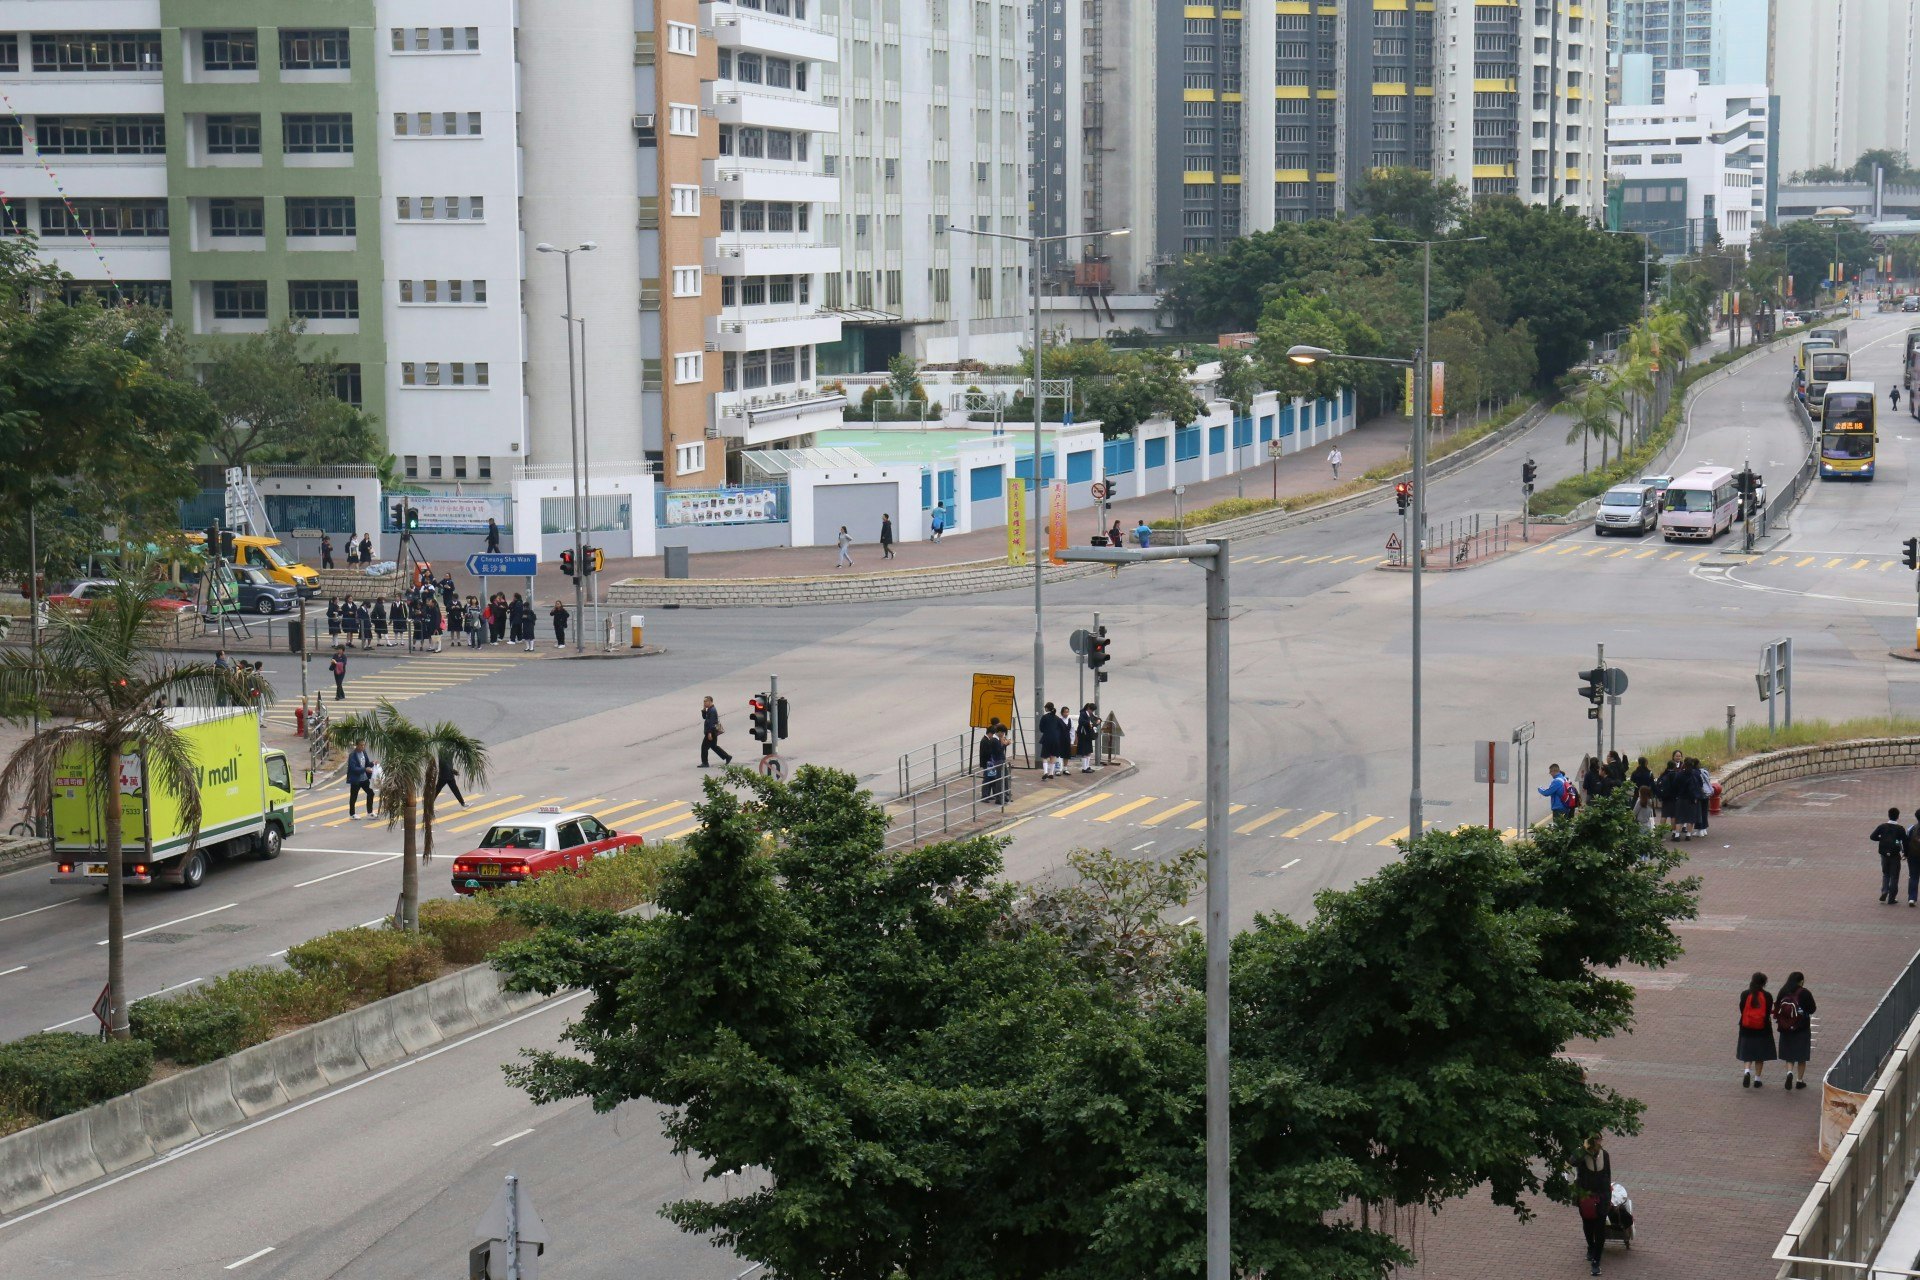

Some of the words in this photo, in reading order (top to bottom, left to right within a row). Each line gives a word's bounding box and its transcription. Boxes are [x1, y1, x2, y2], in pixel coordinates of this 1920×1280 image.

[480, 556, 504, 564] Cheung
[482, 564, 506, 572] 長沙灣
[208, 758, 238, 787] mall
